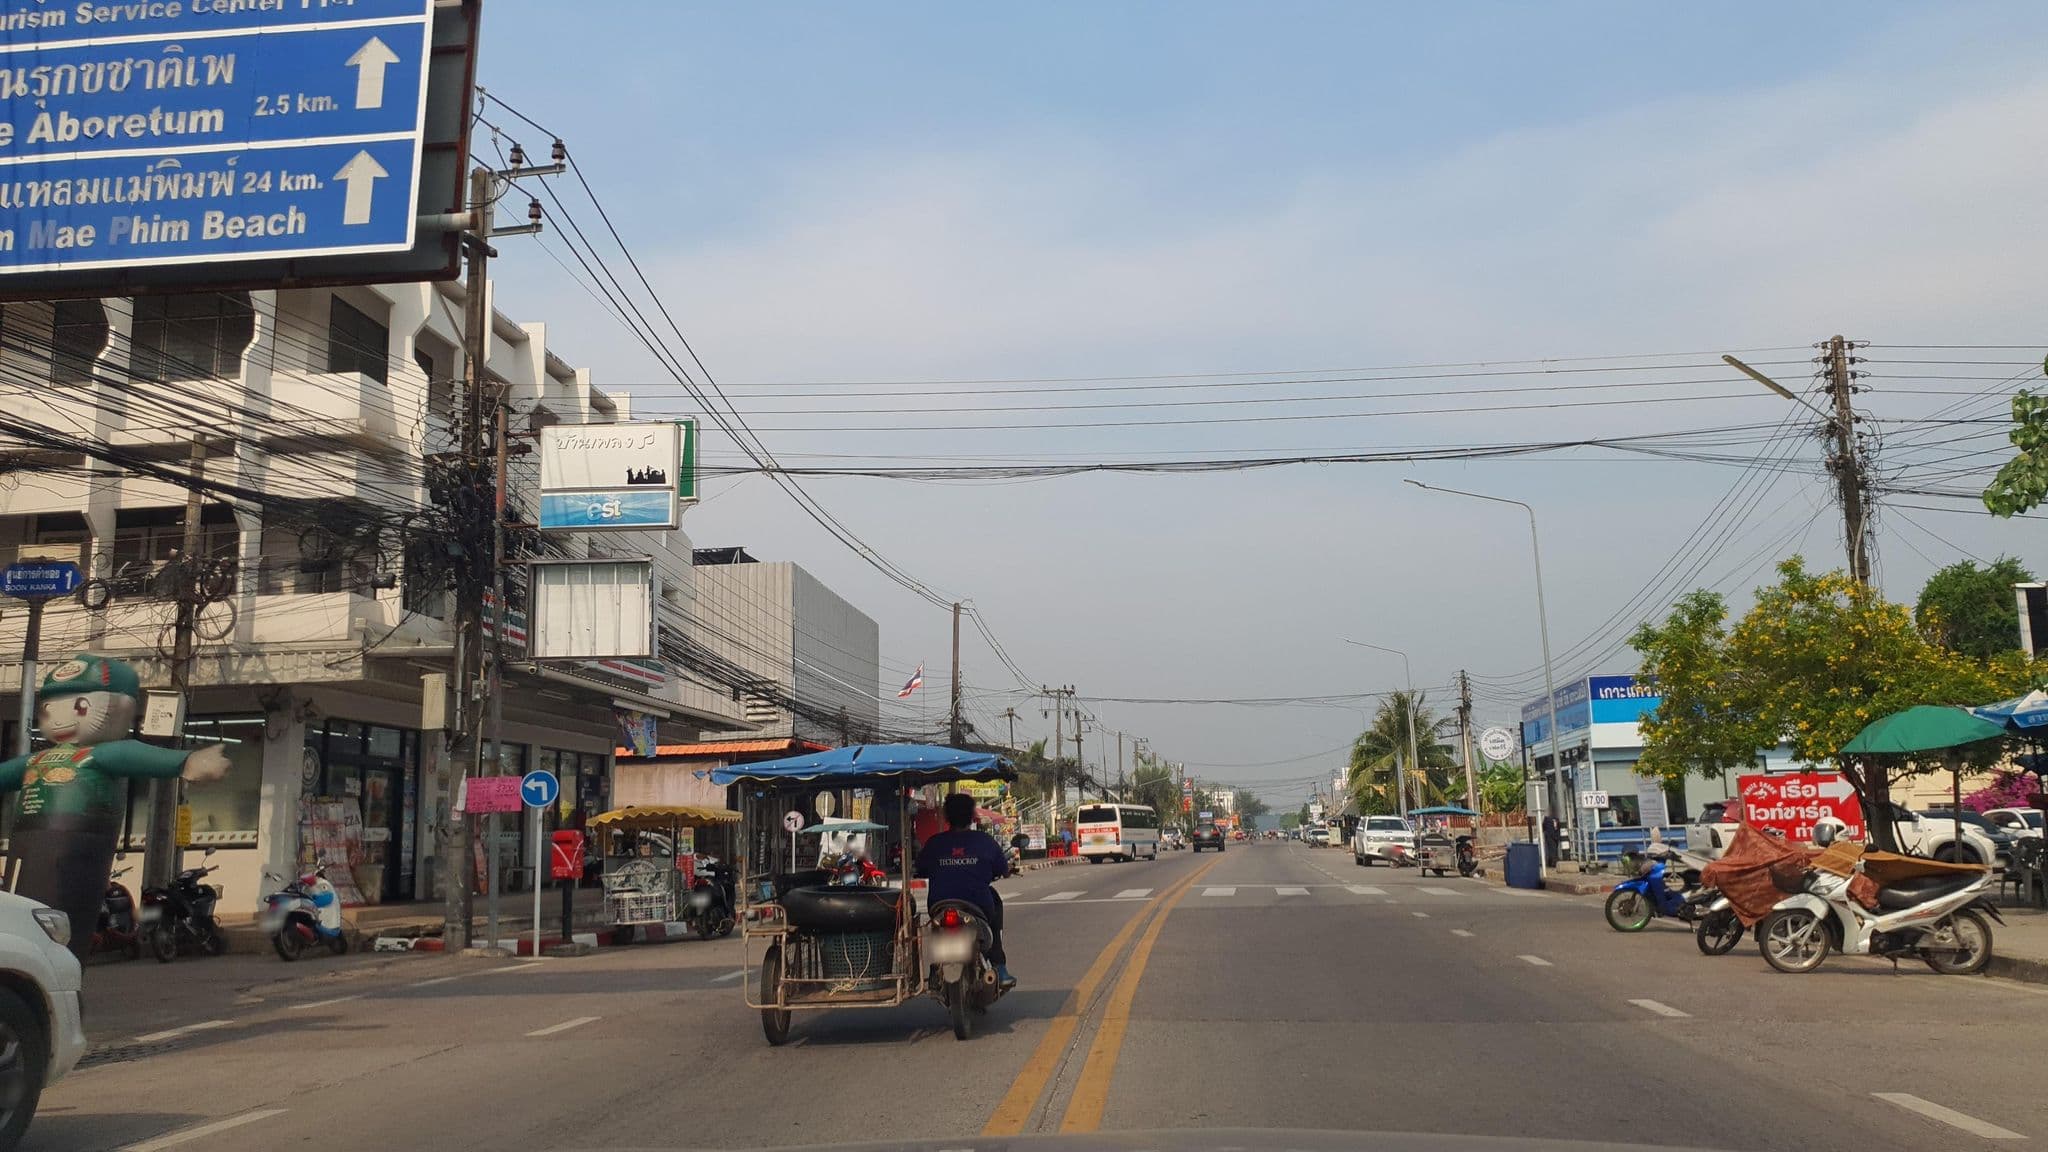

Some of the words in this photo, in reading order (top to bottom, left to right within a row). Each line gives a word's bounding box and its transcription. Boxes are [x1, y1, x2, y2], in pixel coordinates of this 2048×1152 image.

[76, 1, 183, 25] Service
[255, 94, 290, 116] 2.5
[297, 93, 338, 114] km.
[28, 105, 225, 146] Aboretum
[242, 175, 272, 194] 24
[280, 171, 324, 192] km.
[29, 218, 97, 250] Mae
[109, 213, 190, 246] Phim
[202, 206, 307, 241] Beach
[587, 499, 623, 521] est
[65, 570, 73, 589] 1
[1780, 779, 1817, 799] เรือ
[939, 857, 978, 866] TECHNOCROP
